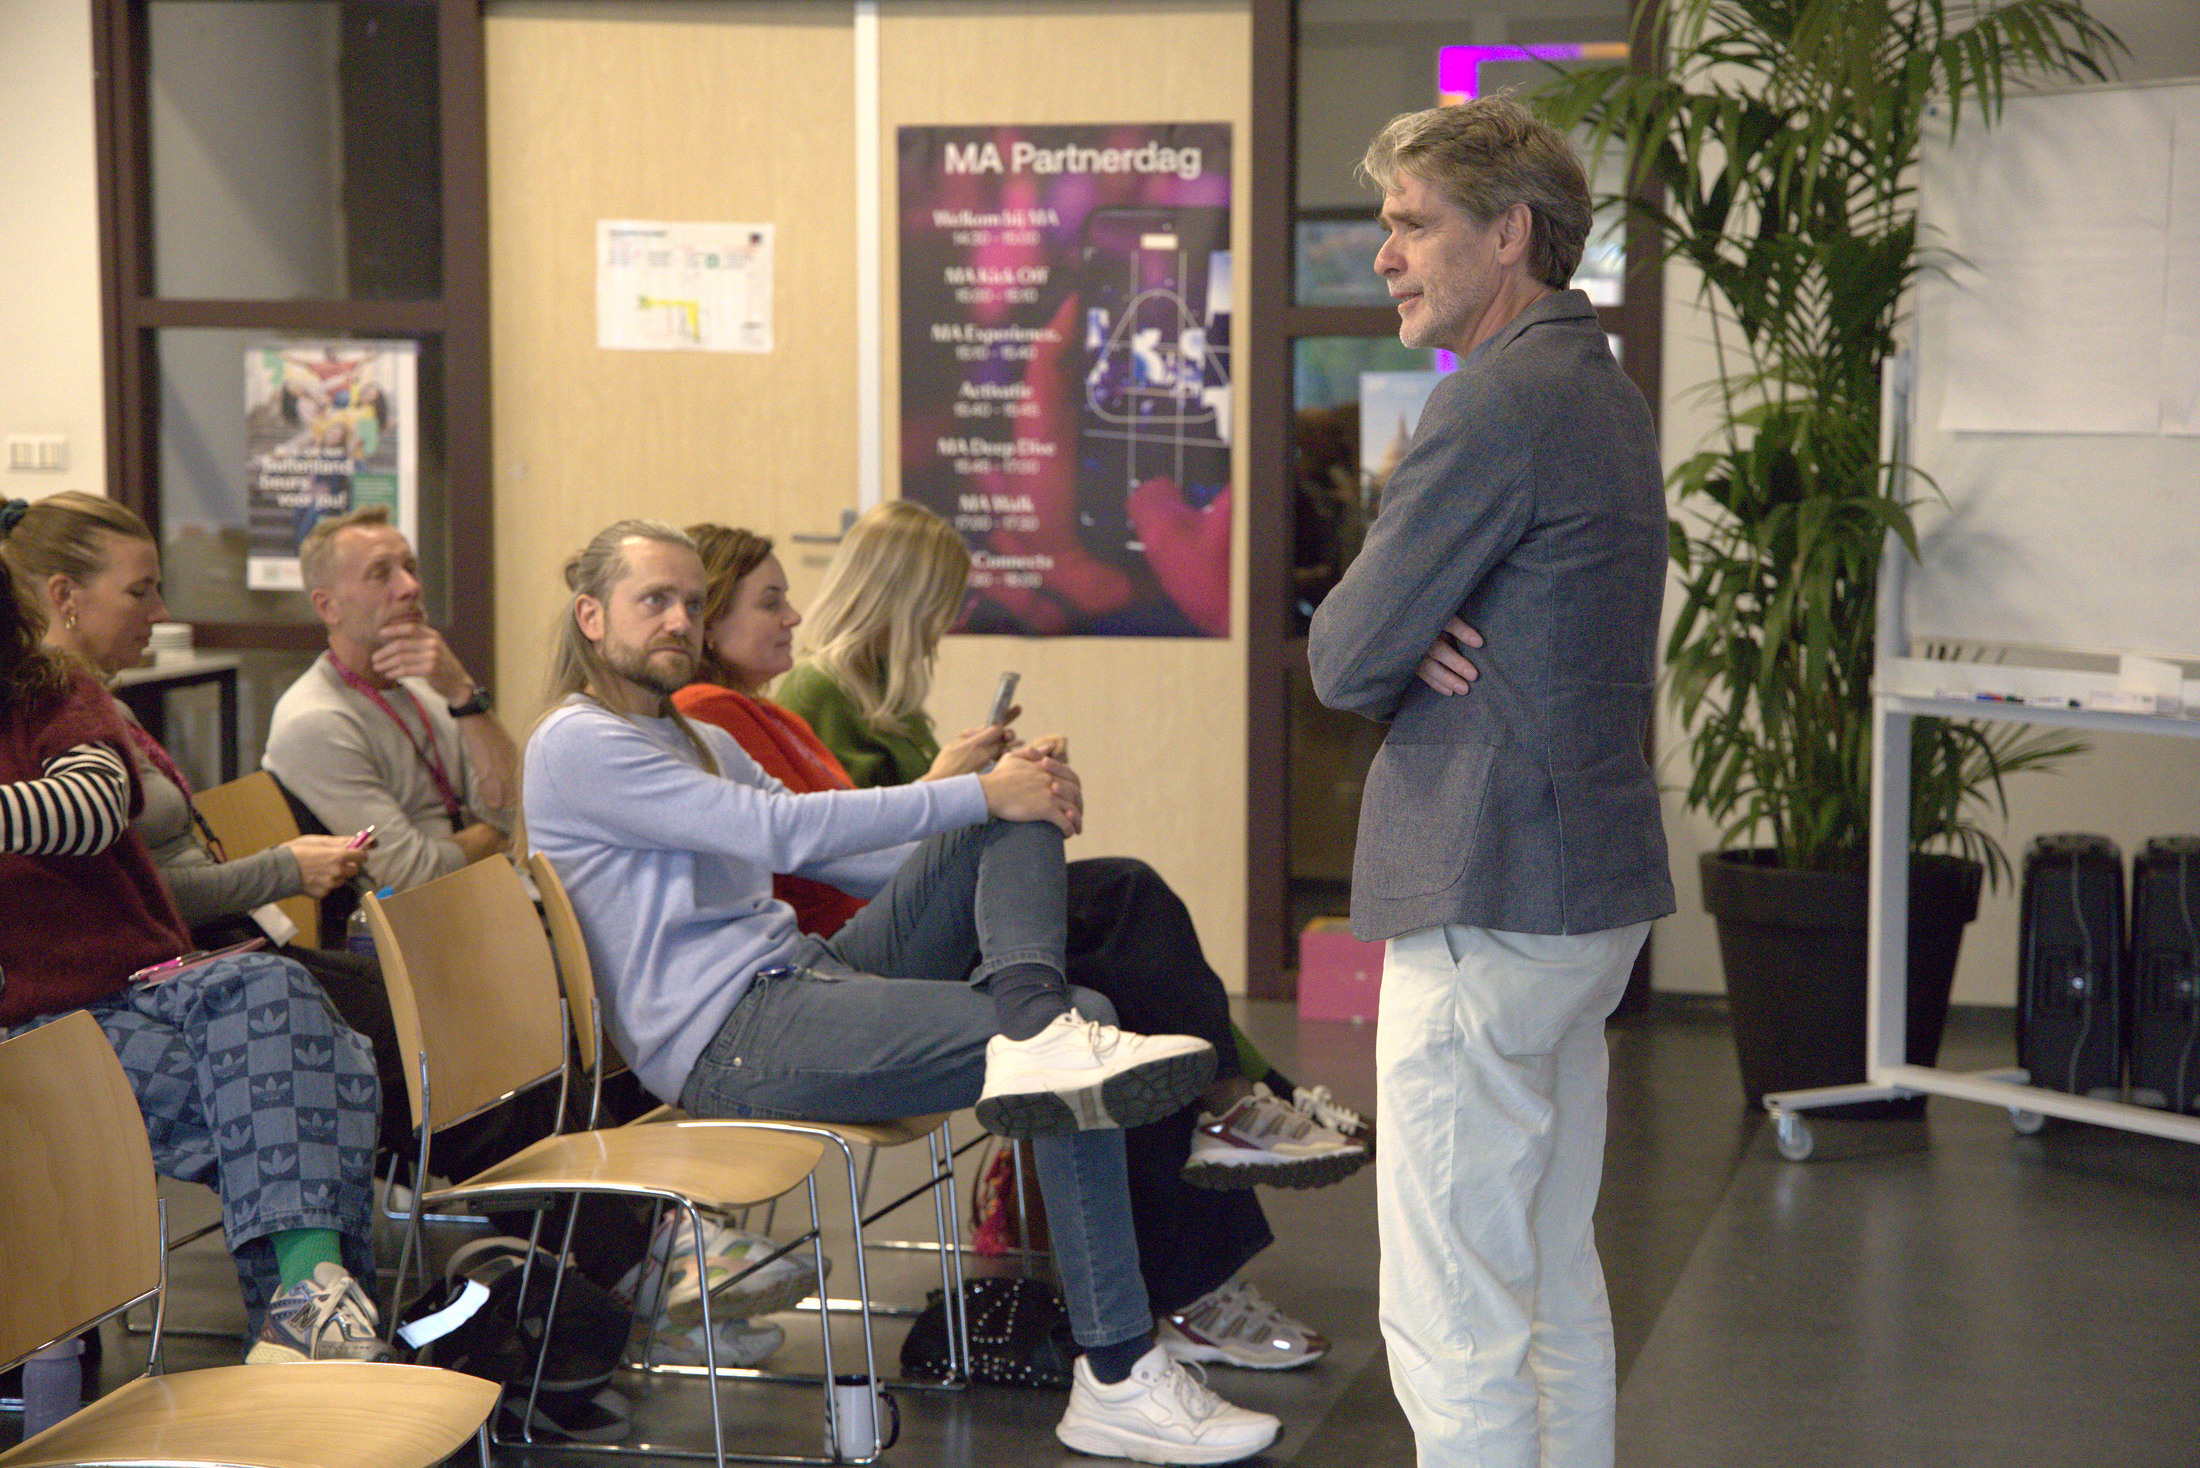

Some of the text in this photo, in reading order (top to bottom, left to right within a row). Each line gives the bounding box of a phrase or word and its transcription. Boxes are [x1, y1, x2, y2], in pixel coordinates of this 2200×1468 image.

[944, 140, 1202, 181] MA Partnerdag
[1028, 209, 1060, 227] MA
[944, 266, 976, 285] MA
[931, 323, 963, 342] MA
[937, 437, 969, 456] MA
[958, 493, 991, 513] MA
